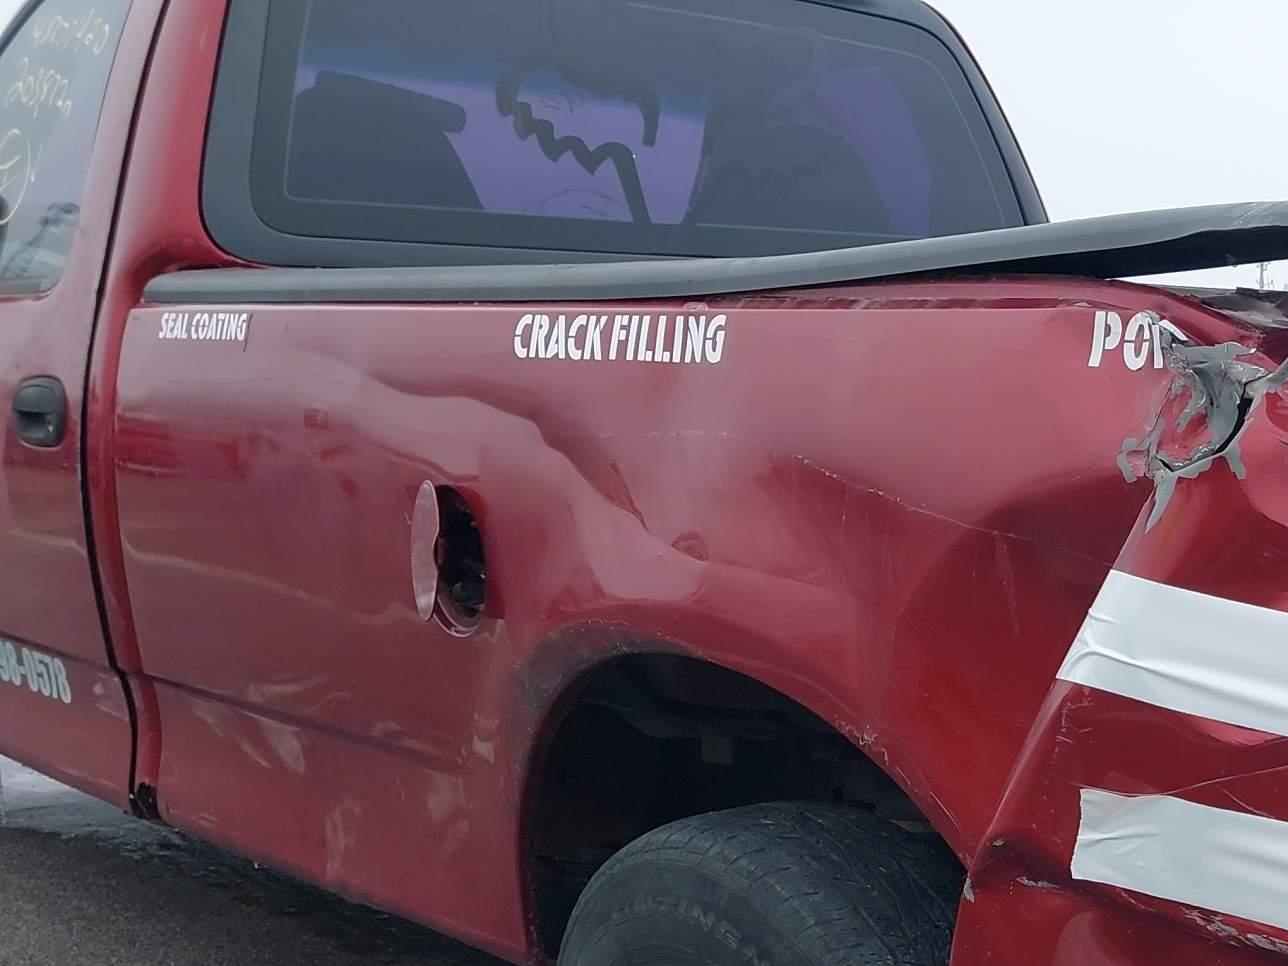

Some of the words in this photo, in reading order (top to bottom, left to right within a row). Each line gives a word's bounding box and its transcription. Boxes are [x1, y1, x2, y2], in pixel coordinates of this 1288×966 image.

[158, 312, 189, 339] SEAL
[190, 312, 248, 341] COATING
[513, 314, 608, 360] CRACK
[608, 314, 727, 364] FILLING
